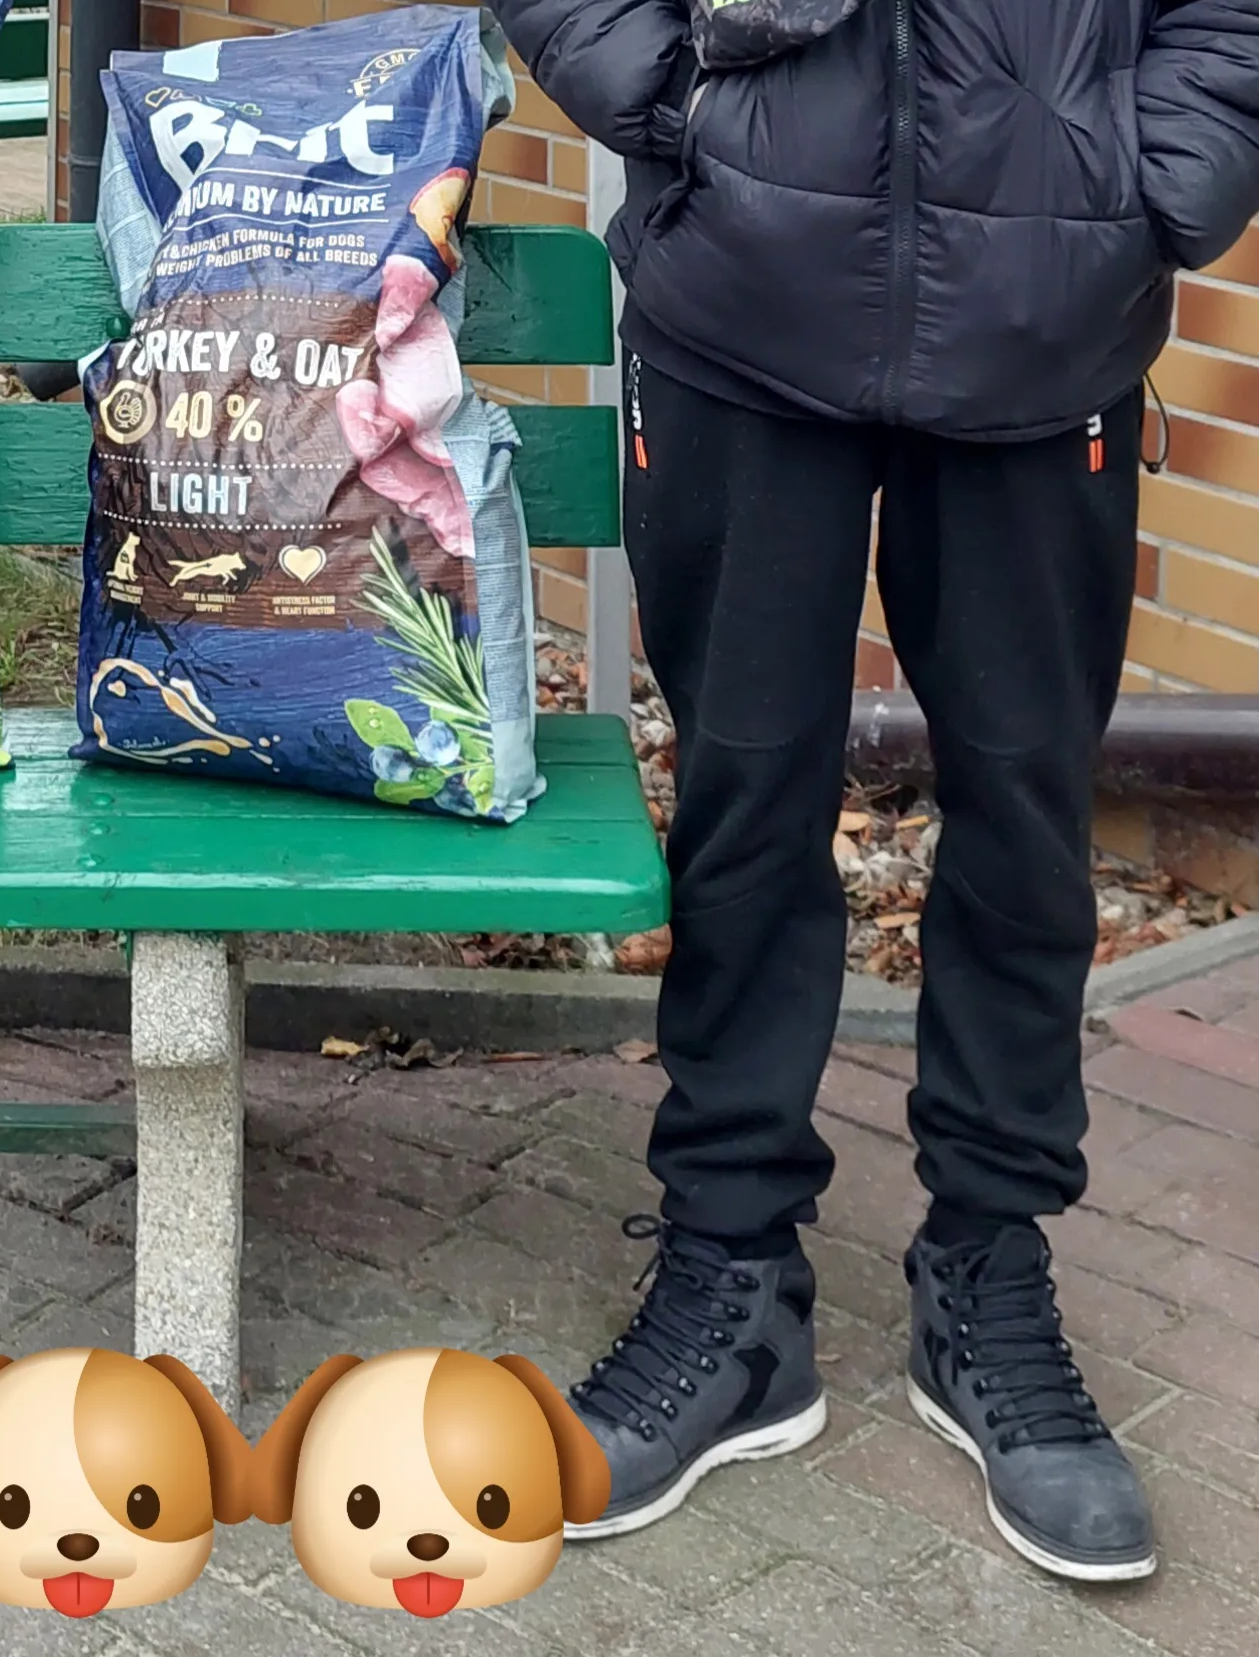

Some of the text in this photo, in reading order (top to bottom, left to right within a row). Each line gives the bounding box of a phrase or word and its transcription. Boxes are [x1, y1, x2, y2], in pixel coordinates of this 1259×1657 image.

[242, 185, 279, 215] BY
[285, 190, 387, 217] NATURE
[205, 243, 272, 267] PROBLEMS
[275, 245, 292, 259] OF
[296, 251, 320, 262] ALL
[325, 249, 378, 267] BREEDS
[233, 228, 295, 245] FORMULA
[299, 236, 325, 249] FOR
[328, 234, 365, 248] DOGS
[250, 332, 282, 380] &
[294, 339, 365, 388] OAT
[165, 391, 264, 442] 40 %
[150, 471, 253, 515] LIGHT
